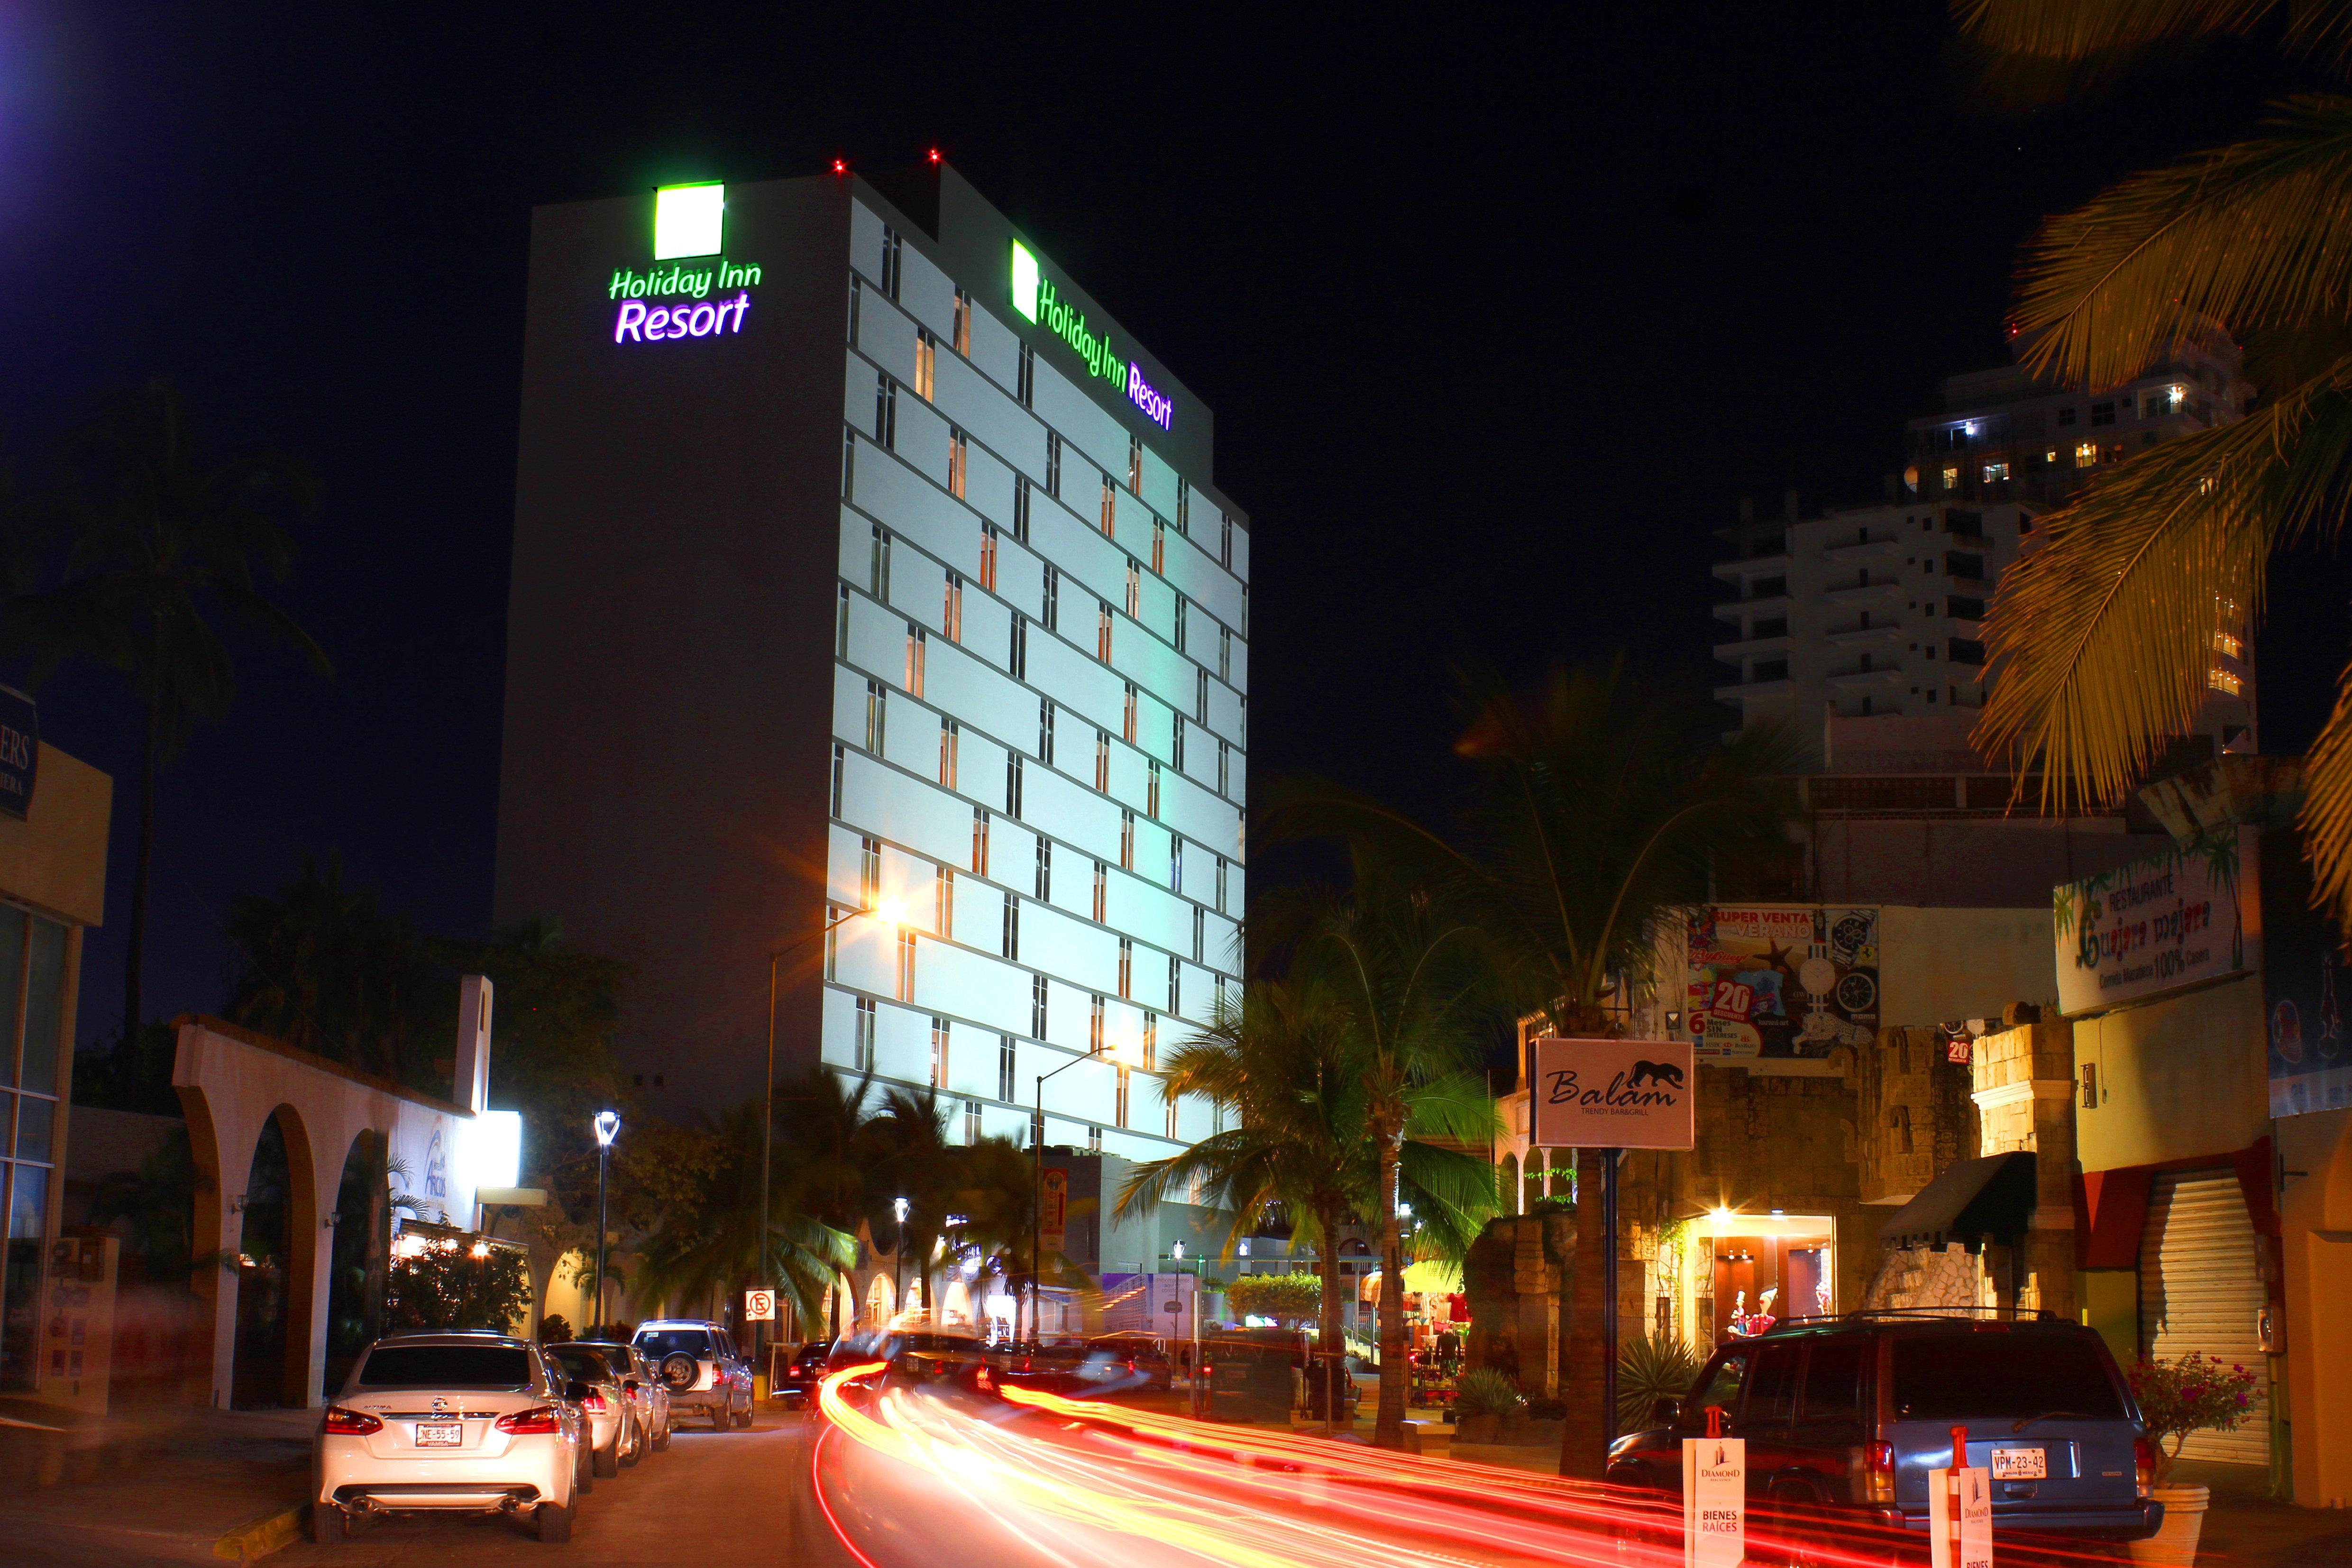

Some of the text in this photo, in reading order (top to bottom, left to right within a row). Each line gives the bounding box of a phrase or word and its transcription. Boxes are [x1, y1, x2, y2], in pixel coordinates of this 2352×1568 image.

[609, 259, 761, 300] Holiday Inn
[615, 293, 750, 343] Resort
[1039, 278, 1172, 431] Holiday Inn Resort
[2110, 874, 2174, 912] RESTAURANTE
[1712, 911, 1809, 924] SUPER VENTA
[1736, 924, 1811, 937] VERANO
[2154, 948, 2185, 978] 100%
[1715, 981, 1750, 1013] 20
[1689, 1013, 1706, 1034] 6
[1949, 1042, 1968, 1059] 20
[1610, 1108, 1649, 1116] BAR&GRILL
[1994, 1456, 2044, 1469] VPM-23-42
[1702, 1469, 1740, 1477] DIAMOND
[1702, 1511, 1737, 1520] BIENES
[1965, 1507, 1988, 1518] DIAMOND
[1702, 1520, 1737, 1532] RAÍCES
